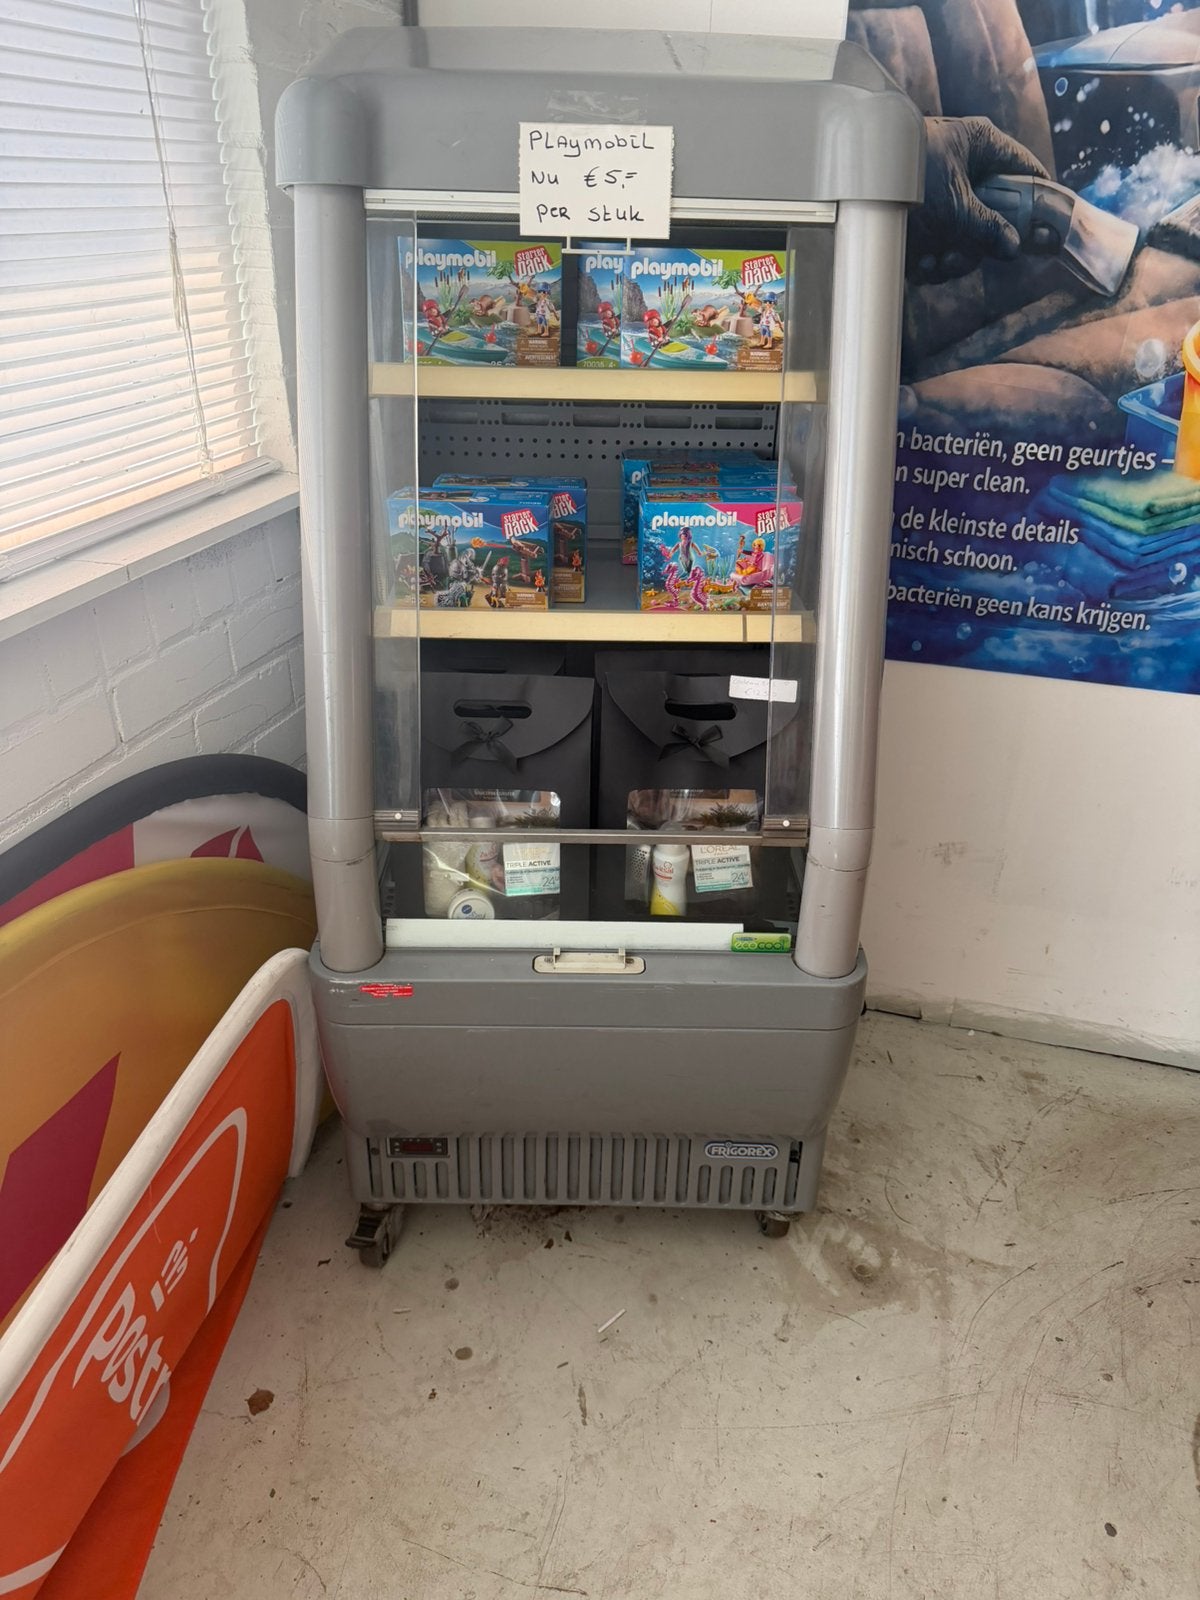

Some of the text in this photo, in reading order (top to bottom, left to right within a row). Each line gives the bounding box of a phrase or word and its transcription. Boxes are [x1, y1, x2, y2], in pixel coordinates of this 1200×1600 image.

[405, 248, 497, 271] playmobil
[631, 257, 723, 279] playmobil
[910, 426, 1008, 463] bacteriën,
[1011, 440, 1063, 466] geen
[1066, 444, 1157, 475] geurtjes
[912, 466, 969, 493] super
[973, 467, 1031, 494] clean.
[398, 512, 484, 529] playmobil
[652, 511, 738, 530] playmobil
[900, 506, 1080, 545] de kleinste details
[942, 545, 1018, 572] schoon.
[887, 579, 1151, 633] bacteriën geen kans krijgen.
